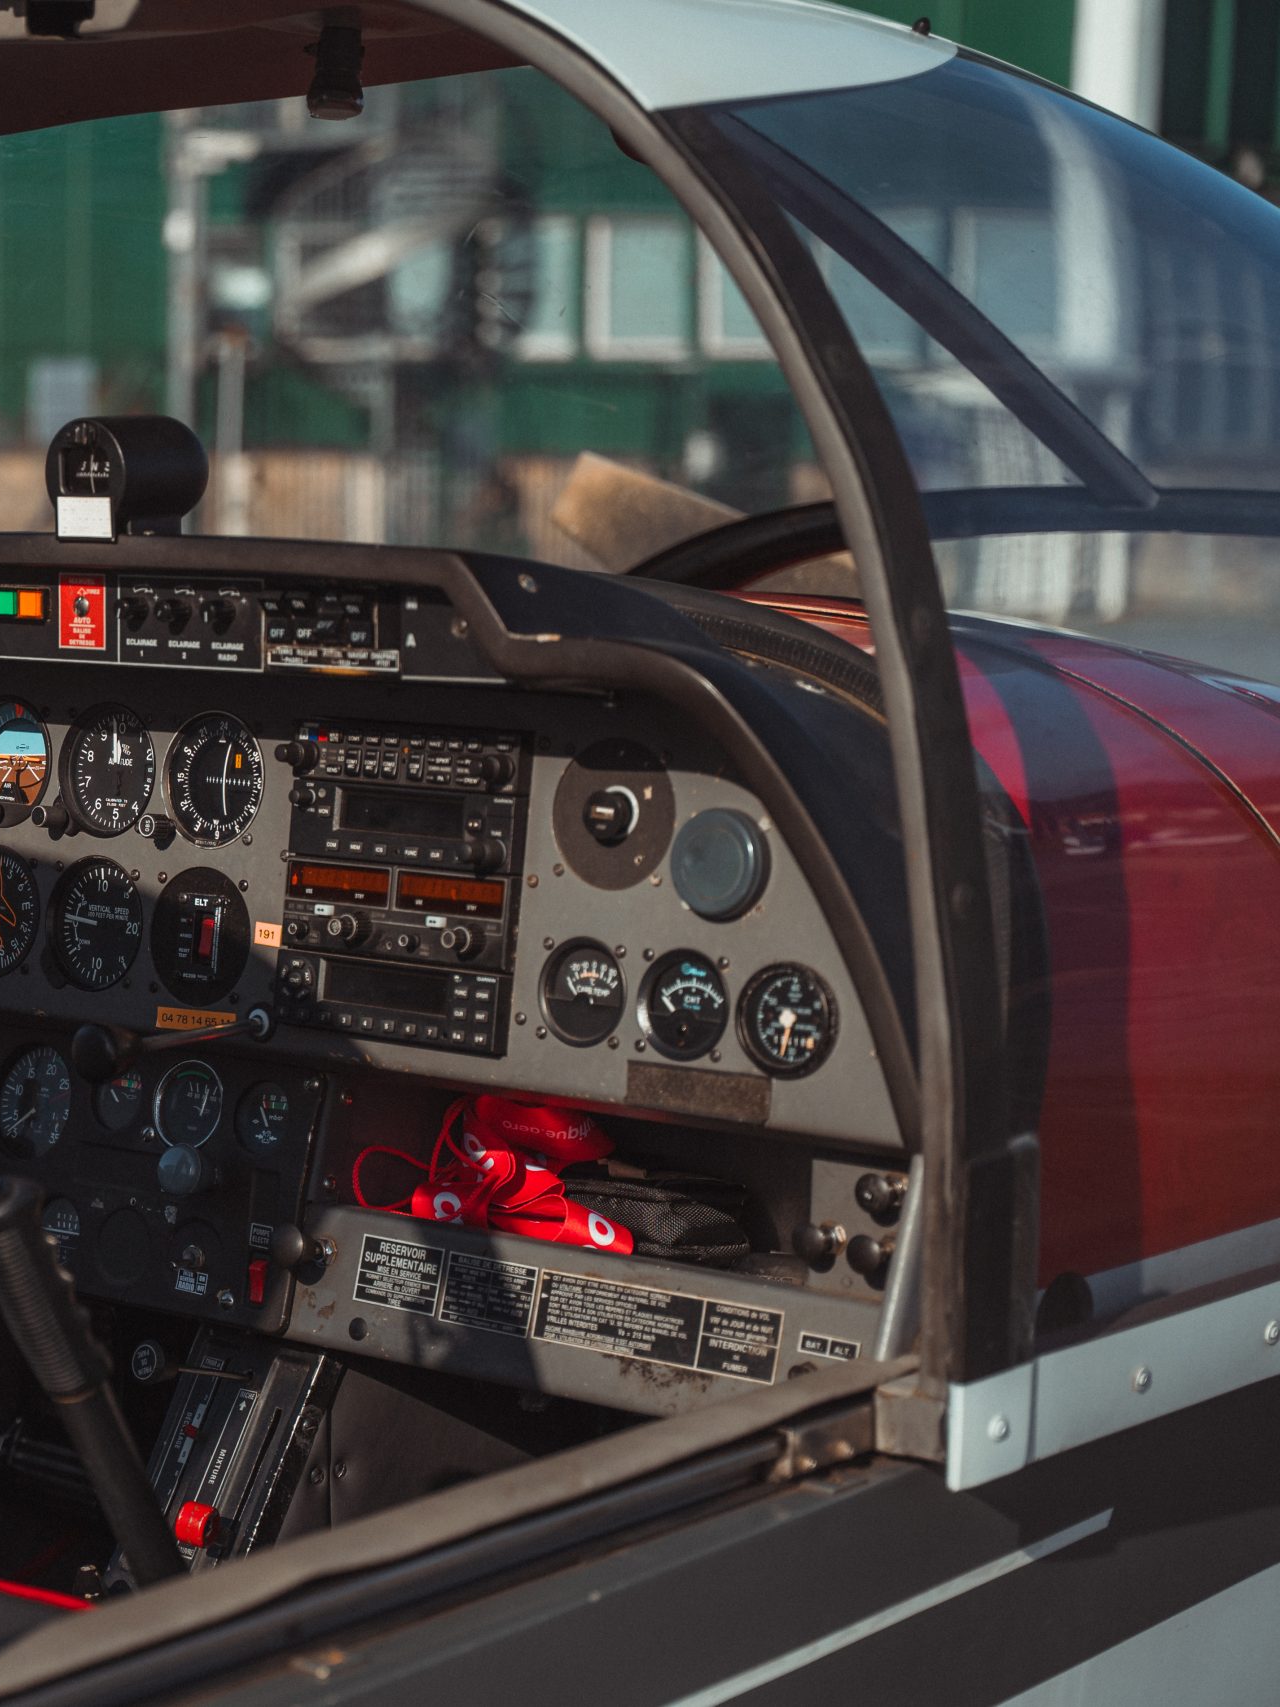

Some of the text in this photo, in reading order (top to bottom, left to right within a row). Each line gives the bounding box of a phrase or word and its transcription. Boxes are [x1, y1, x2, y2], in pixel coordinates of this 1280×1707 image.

[270, 628, 285, 638] OFF
[296, 629, 312, 638] OFF
[351, 632, 367, 642] OFF
[126, 638, 158, 648] ECLAIRAGE
[168, 640, 200, 649] ECLAIRAGE
[211, 642, 244, 651] ECLAIRAGE
[217, 653, 237, 662] RADIO
[220, 721, 228, 730] 24
[100, 729, 108, 741] 9
[87, 750, 94, 762] 8
[146, 748, 153, 761] 2
[184, 747, 192, 756] S
[84, 776, 92, 787] 7
[177, 772, 185, 782] 15
[94, 798, 102, 810] 6
[131, 801, 139, 813] 4
[180, 801, 190, 811] 12
[112, 808, 119, 820] 5
[6, 869, 13, 880] 3
[17, 884, 23, 892] 6
[97, 880, 109, 893] 10
[22, 901, 30, 911] E
[195, 898, 209, 907] ELT
[88, 903, 129, 915] VERTICAL SPEED
[125, 921, 138, 935] 20
[259, 929, 276, 940] 191
[11, 937, 19, 950] 15
[91, 957, 103, 971] 10
[684, 996, 702, 1004] CHT
[162, 1013, 173, 1022] 04
[177, 1015, 188, 1024] 78
[192, 1016, 202, 1025] 14
[27, 1067, 36, 1079] 15
[46, 1063, 57, 1075] 20
[15, 1084, 24, 1096] 10
[59, 1078, 70, 1090] 25
[379, 1240, 426, 1261] RESERVOIR
[364, 1250, 437, 1276] SUPPLEMENTAIRE
[457, 1256, 527, 1275] BALISE DE DETRESSE
[376, 1264, 421, 1280] MISE EN SERVICE
[178, 1281, 195, 1292] RADIO
[372, 1279, 393, 1290] ARRIERE
[400, 1285, 420, 1296] OUVERT
[387, 1298, 401, 1306] TIREE
[715, 1304, 749, 1317] CONDITIONS
[758, 1312, 770, 1321] VOL
[546, 1314, 567, 1325] VRILLES
[568, 1319, 598, 1331] INTERDITES
[729, 1319, 745, 1329] JOUR
[760, 1325, 773, 1334] NUIT
[720, 1328, 734, 1337] zone
[734, 1331, 745, 1339] non
[708, 1338, 768, 1357] INTERDICTION
[805, 1339, 823, 1351] BAT.
[721, 1362, 747, 1373] FUMER
[241, 1391, 255, 1401] RICHE
[208, 1449, 227, 1485] MIXTURE
